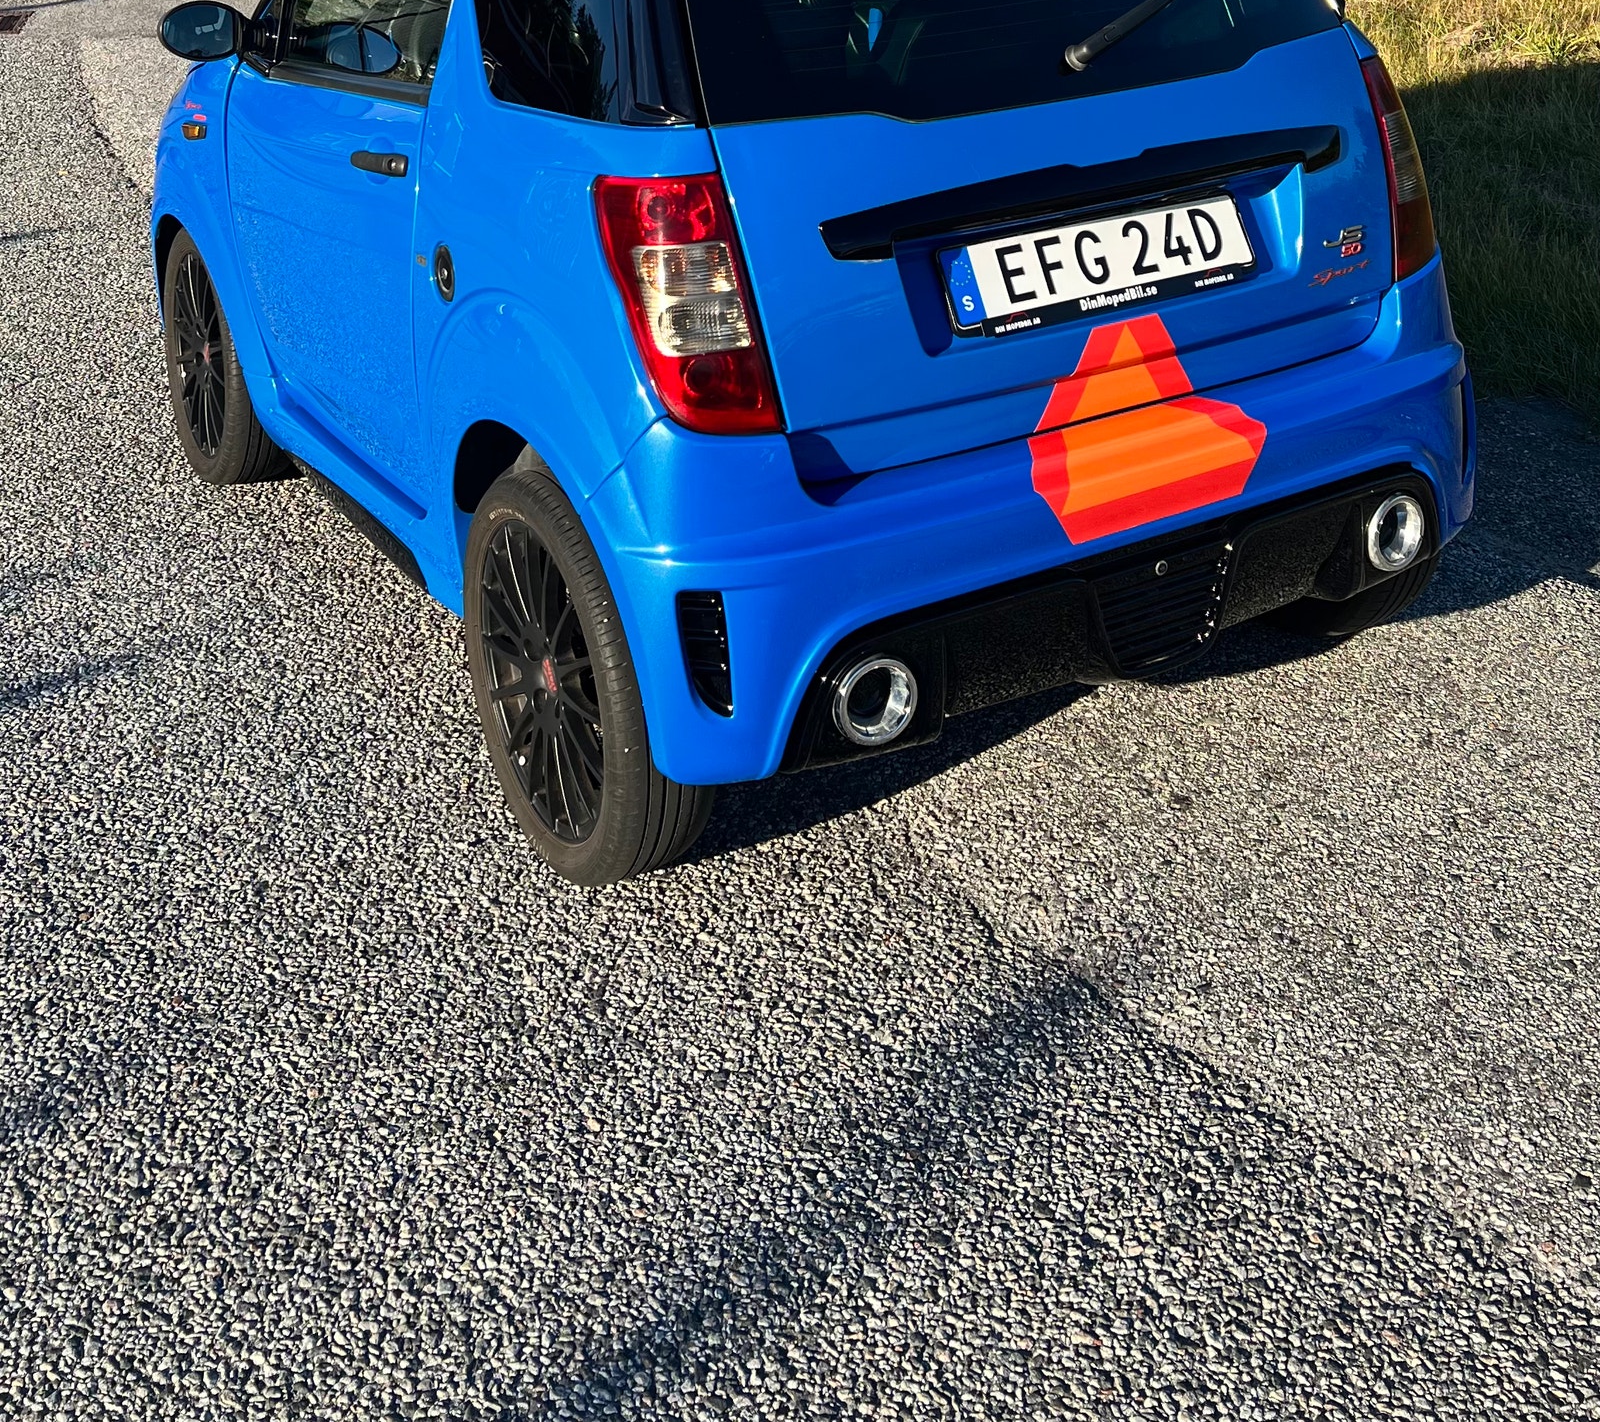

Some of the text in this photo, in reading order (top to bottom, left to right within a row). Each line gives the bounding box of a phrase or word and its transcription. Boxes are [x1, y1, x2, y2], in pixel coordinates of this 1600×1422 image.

[1323, 225, 1363, 248] JS
[995, 208, 1223, 304] EFG 24D
[1341, 242, 1362, 258] 50
[1308, 259, 1370, 288] Sport
[962, 295, 975, 312] S
[1079, 285, 1158, 311] DinMopedBil.se
